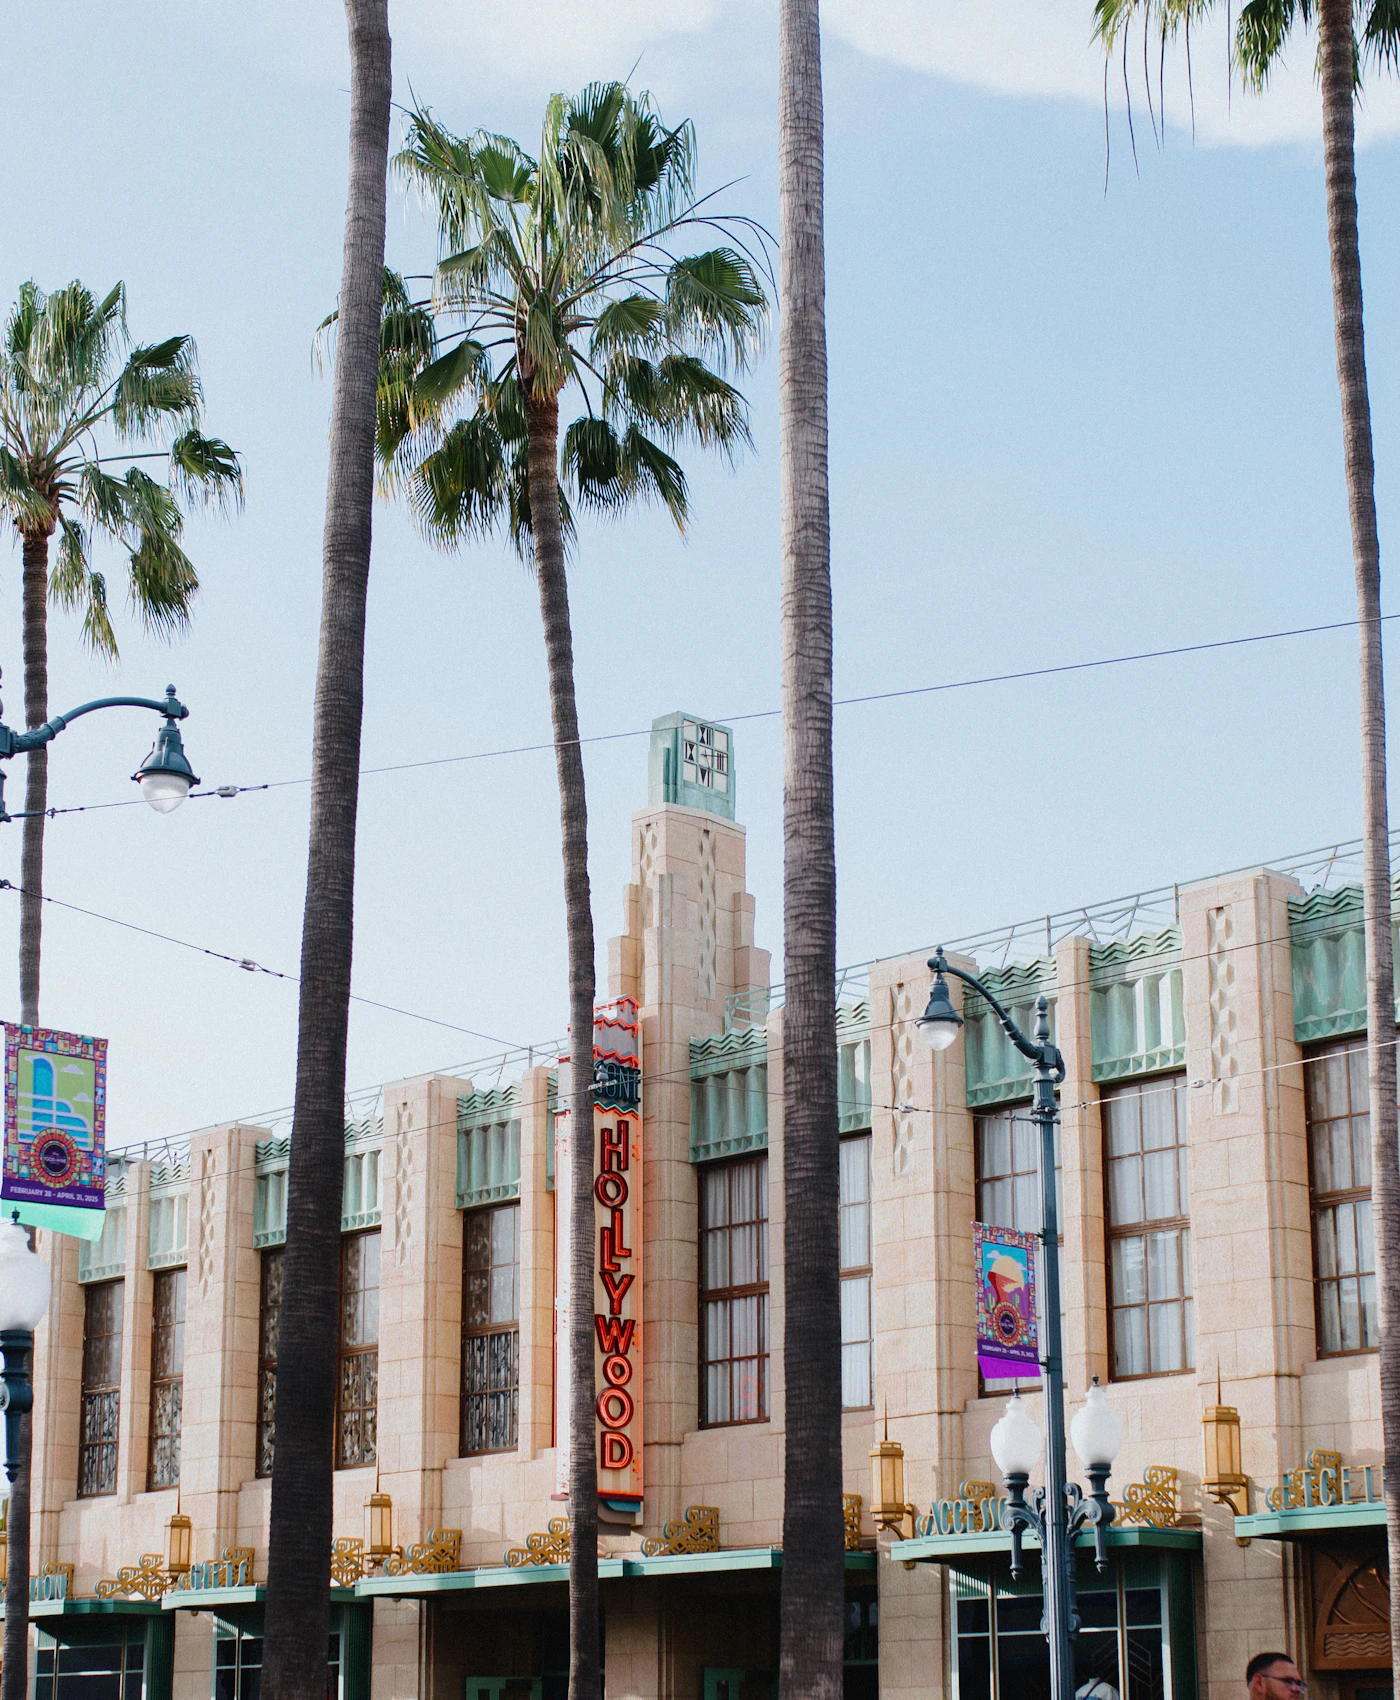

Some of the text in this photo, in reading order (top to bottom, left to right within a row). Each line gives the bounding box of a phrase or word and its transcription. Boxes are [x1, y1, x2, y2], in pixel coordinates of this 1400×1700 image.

[10, 1186, 42, 1196] FEBRUARY
[57, 1192, 75, 1200] APRIL
[594, 1119, 637, 1470] HOLLYWOOD
[923, 1495, 1040, 1536] ACCESSO
[190, 1559, 247, 1590] GIFTS
